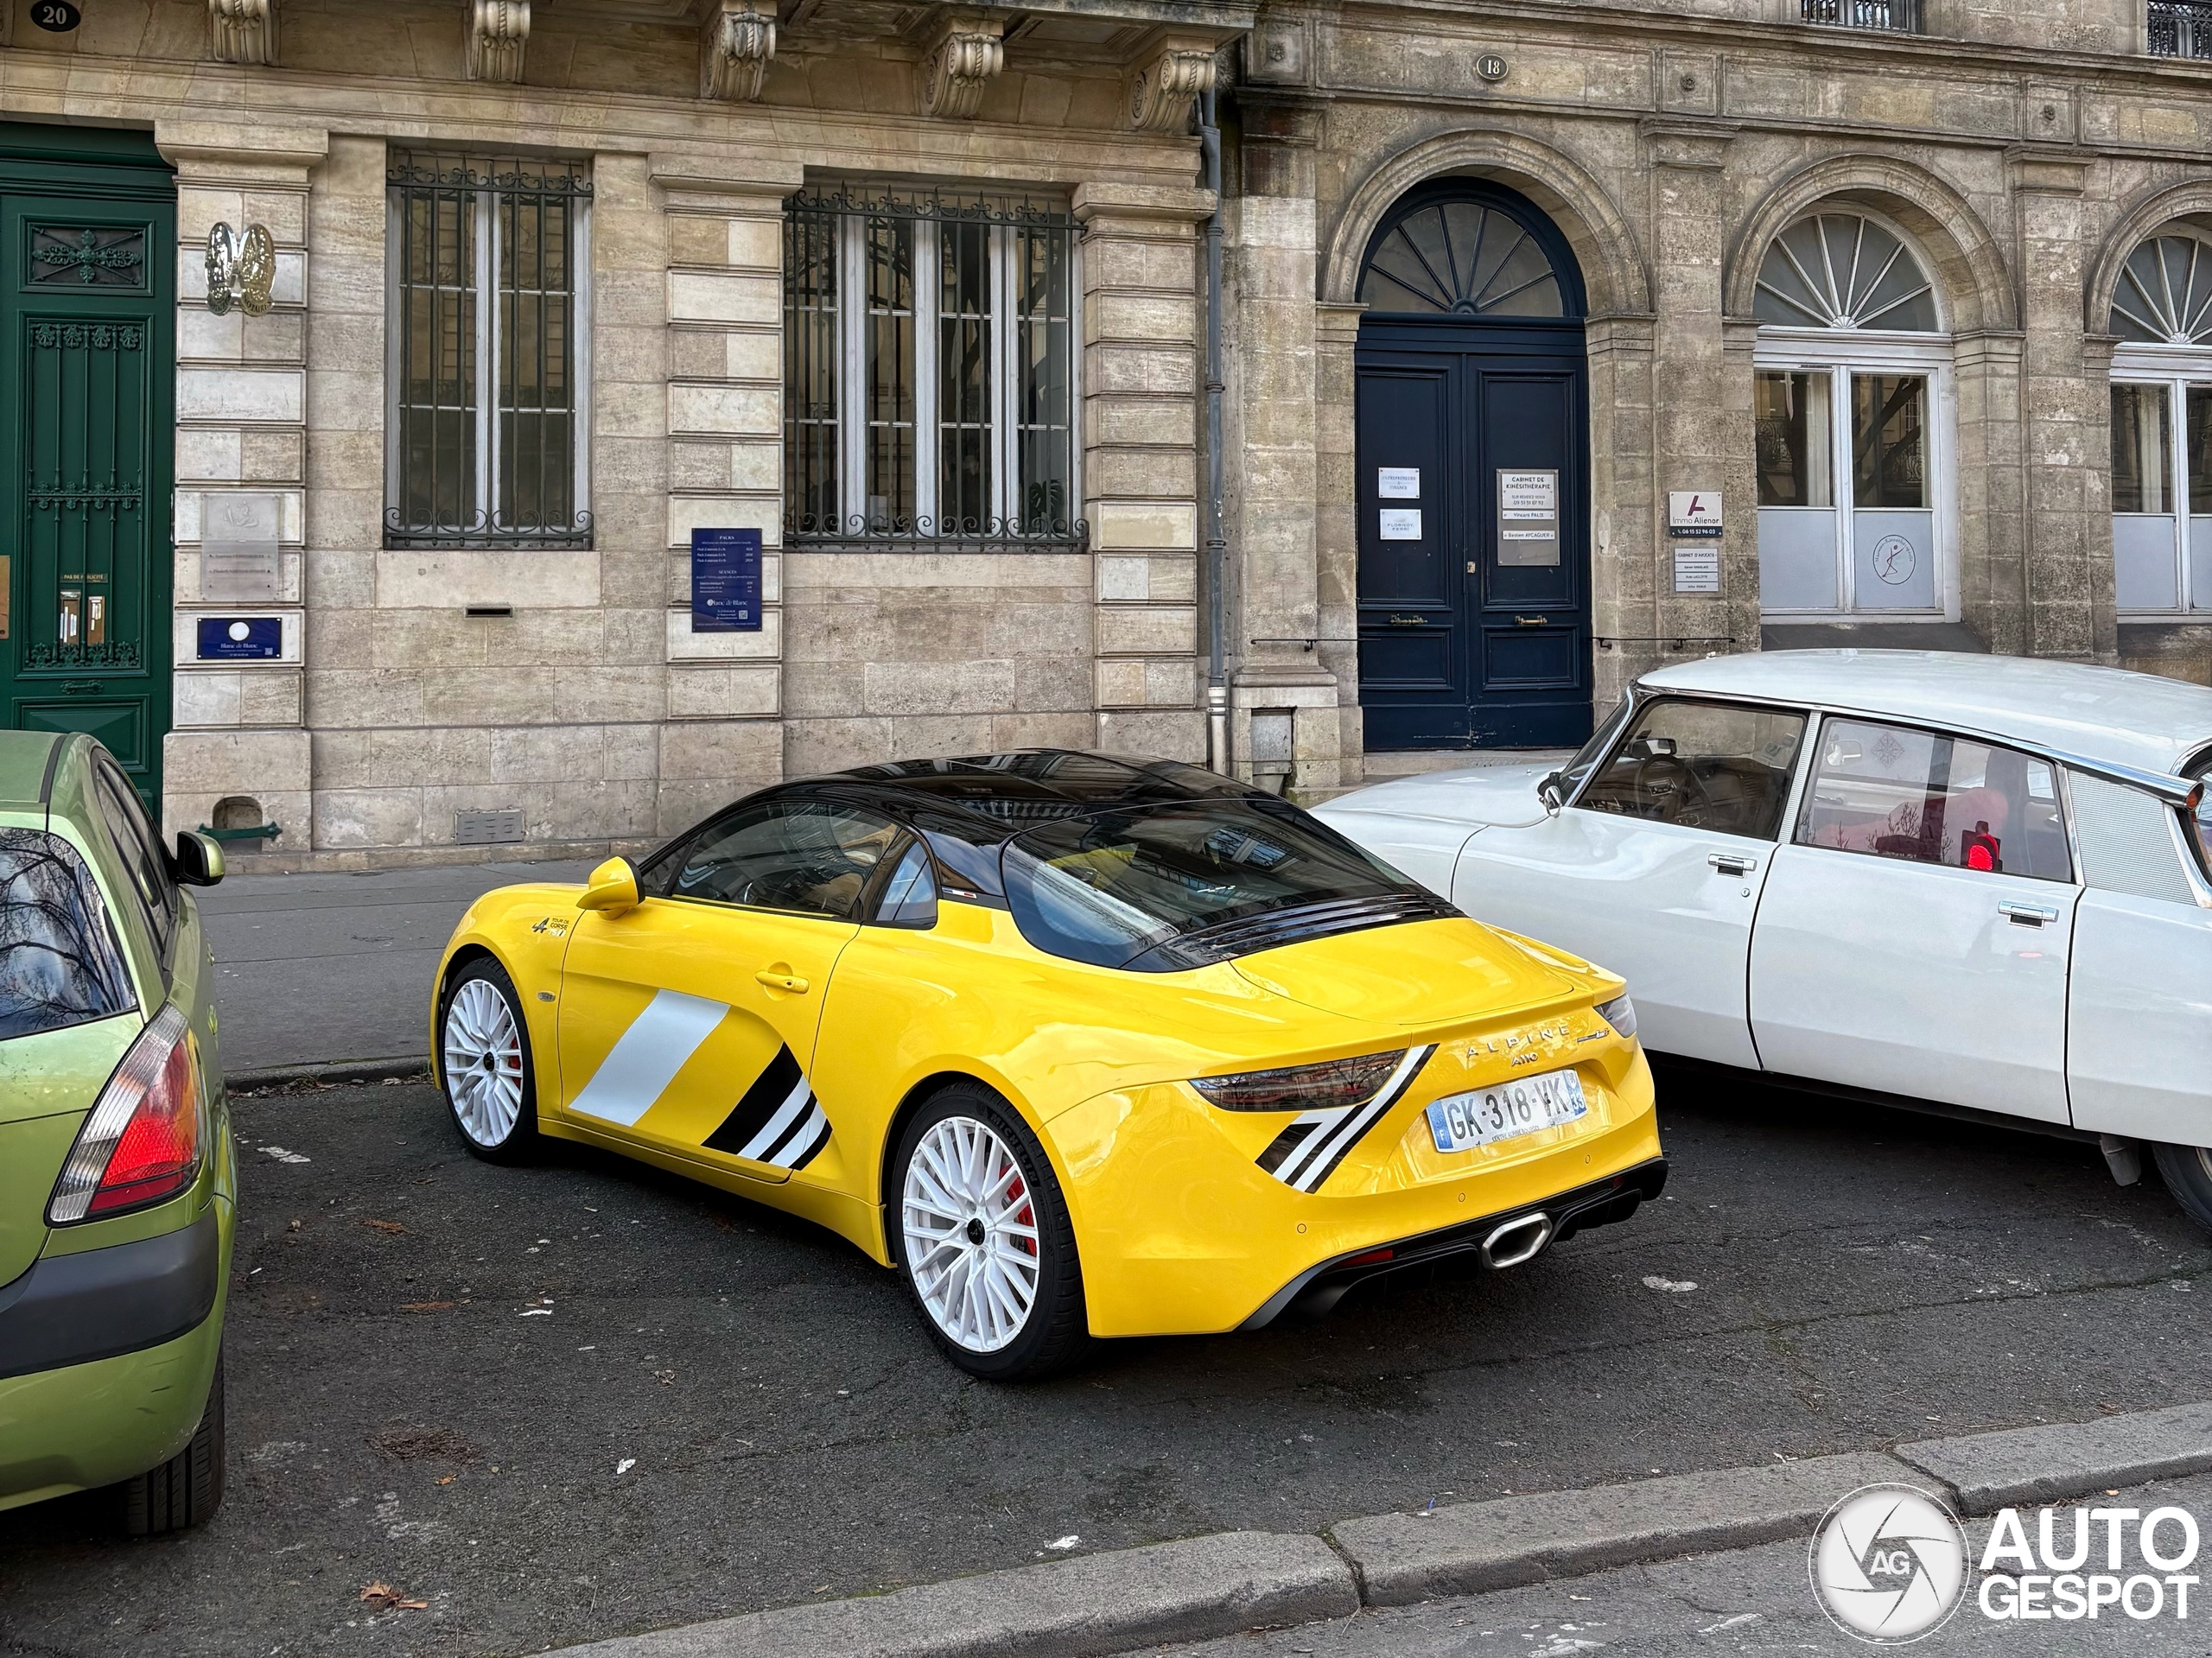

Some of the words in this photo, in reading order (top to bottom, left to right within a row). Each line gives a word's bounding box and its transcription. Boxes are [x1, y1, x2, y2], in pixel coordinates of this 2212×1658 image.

[42, 6, 67, 24] 20
[1487, 60, 1500, 74] 18
[1466, 1024, 1570, 1058] ALPINE
[1511, 1052, 1539, 1068] A110
[1446, 1077, 1569, 1140] GK-318-VK
[1571, 1092, 1585, 1110] 33
[990, 1112, 1038, 1183] MICHELIN
